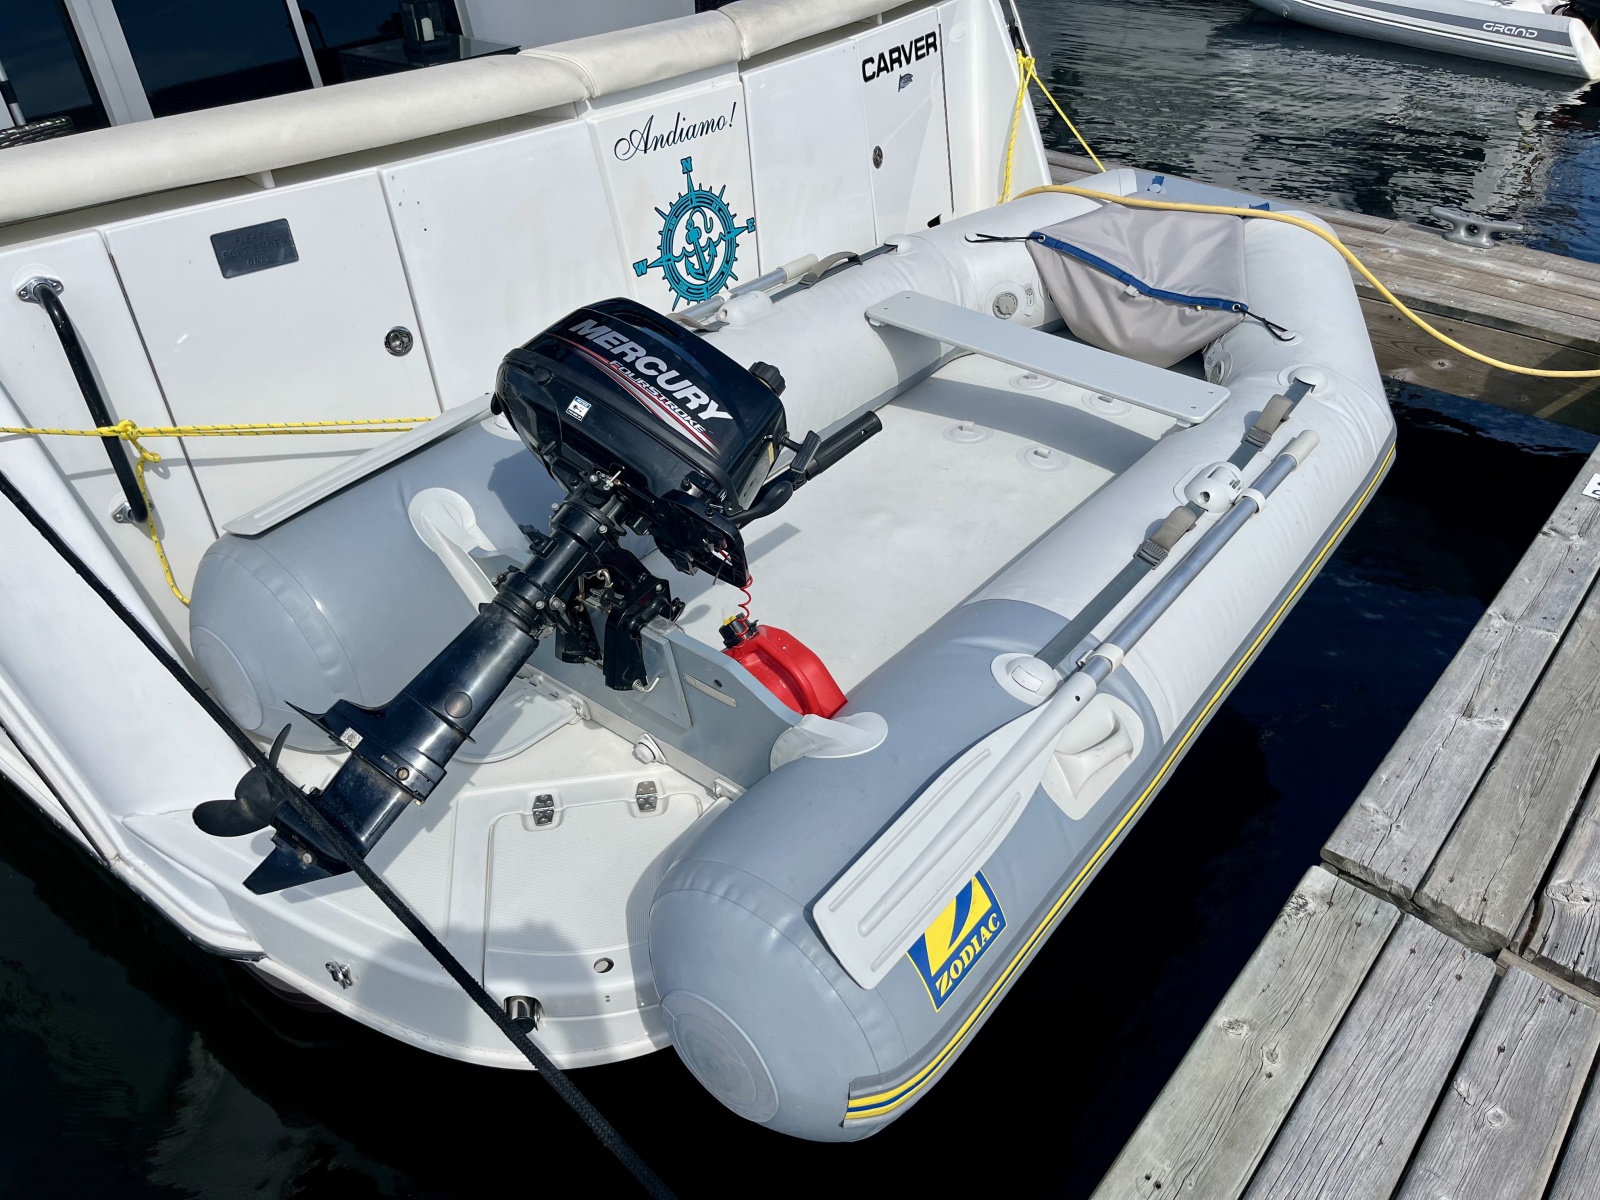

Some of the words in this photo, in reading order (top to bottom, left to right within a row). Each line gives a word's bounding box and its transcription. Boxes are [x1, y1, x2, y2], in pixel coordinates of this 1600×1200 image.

[1482, 22, 1538, 38] GRAND
[862, 31, 937, 83] CARVER
[614, 102, 736, 161] Andiamo!
[680, 156, 693, 174] N
[746, 217, 756, 233] E
[235, 230, 271, 245] PLEASE
[222, 246, 250, 260] SOFT
[253, 237, 288, 252] SHOES
[247, 254, 271, 266] ONLY
[633, 259, 648, 277] W
[569, 319, 733, 420] MERCURY
[609, 360, 706, 433] FOURSTROKE
[935, 913, 1000, 998] ZODIAC
